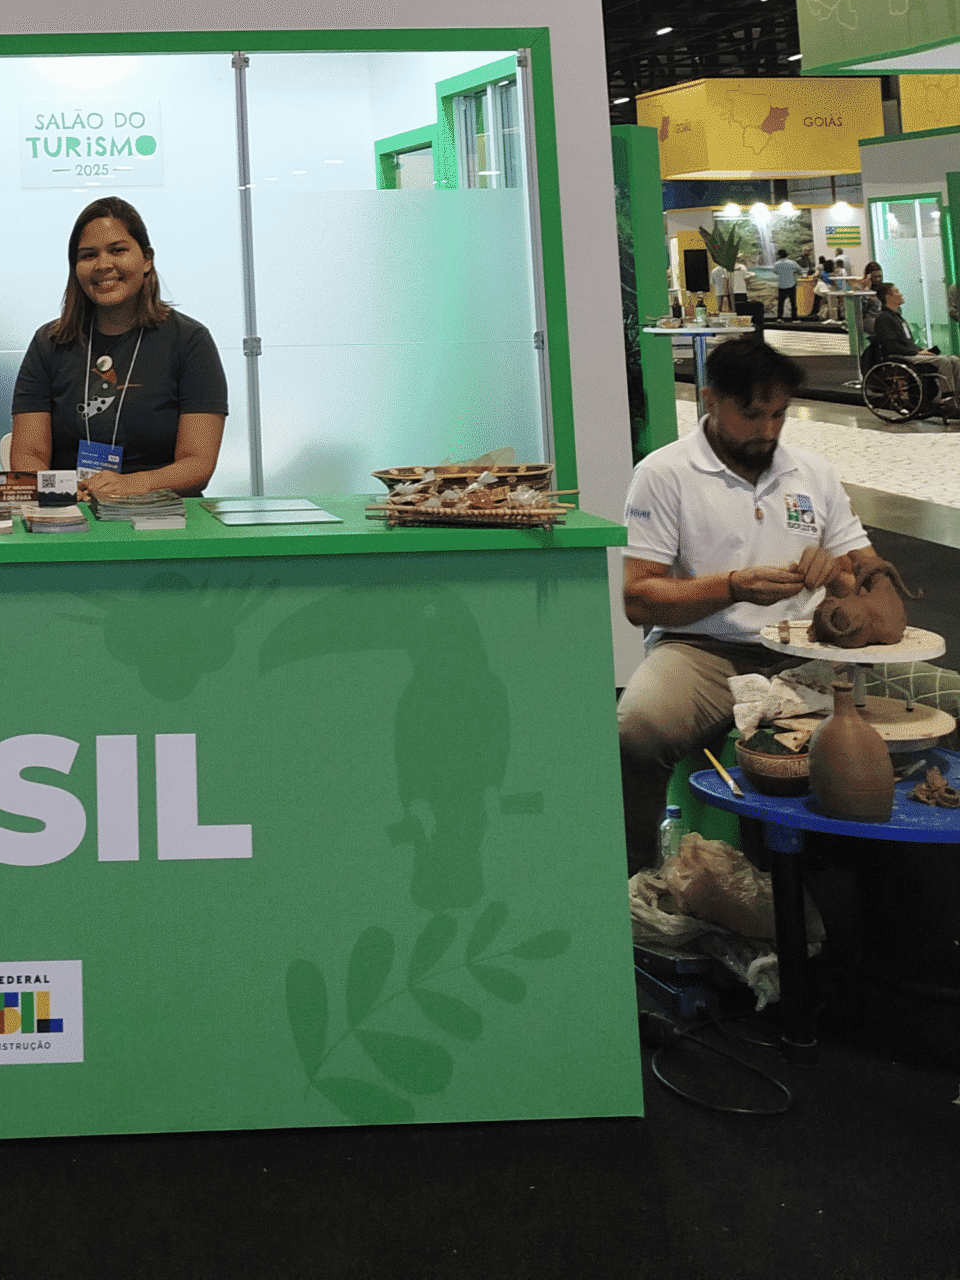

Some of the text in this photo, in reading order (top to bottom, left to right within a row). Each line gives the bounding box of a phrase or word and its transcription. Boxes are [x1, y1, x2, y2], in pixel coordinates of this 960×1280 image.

[34, 108, 146, 130] SALÃO DO
[803, 114, 843, 128] GOIÁS
[74, 163, 110, 177] 2025
